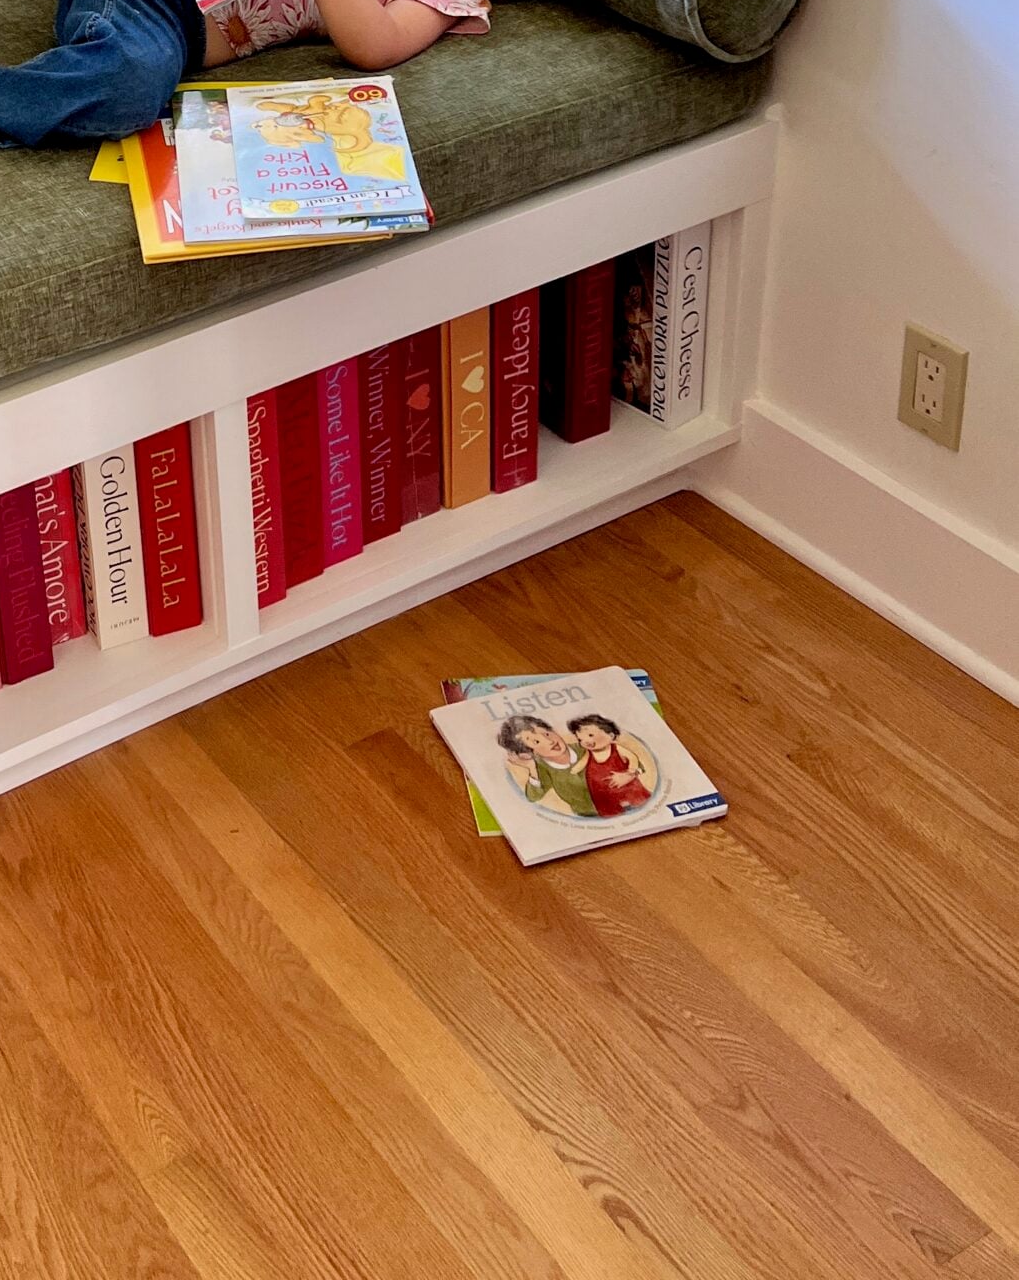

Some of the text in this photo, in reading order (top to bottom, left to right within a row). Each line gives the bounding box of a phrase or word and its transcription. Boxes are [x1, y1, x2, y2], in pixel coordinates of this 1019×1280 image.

[257, 163, 331, 178] Flies a
[264, 150, 310, 164] Kite
[267, 176, 349, 193] Biscuit
[459, 350, 485, 450] I CA
[503, 306, 535, 460] Fancy Ideas
[677, 310, 700, 401] Cheese
[325, 365, 353, 550] Some Like It Hot
[367, 345, 392, 522] Winner, Winner
[404, 368, 431, 457] I NY
[99, 455, 133, 605] Golden Hour
[248, 406, 274, 595] Spaghetti Western
[9, 565, 46, 665] Flushed
[40, 540, 69, 625] Amore
[481, 683, 592, 723] Listen
[688, 798, 719, 810] Library
